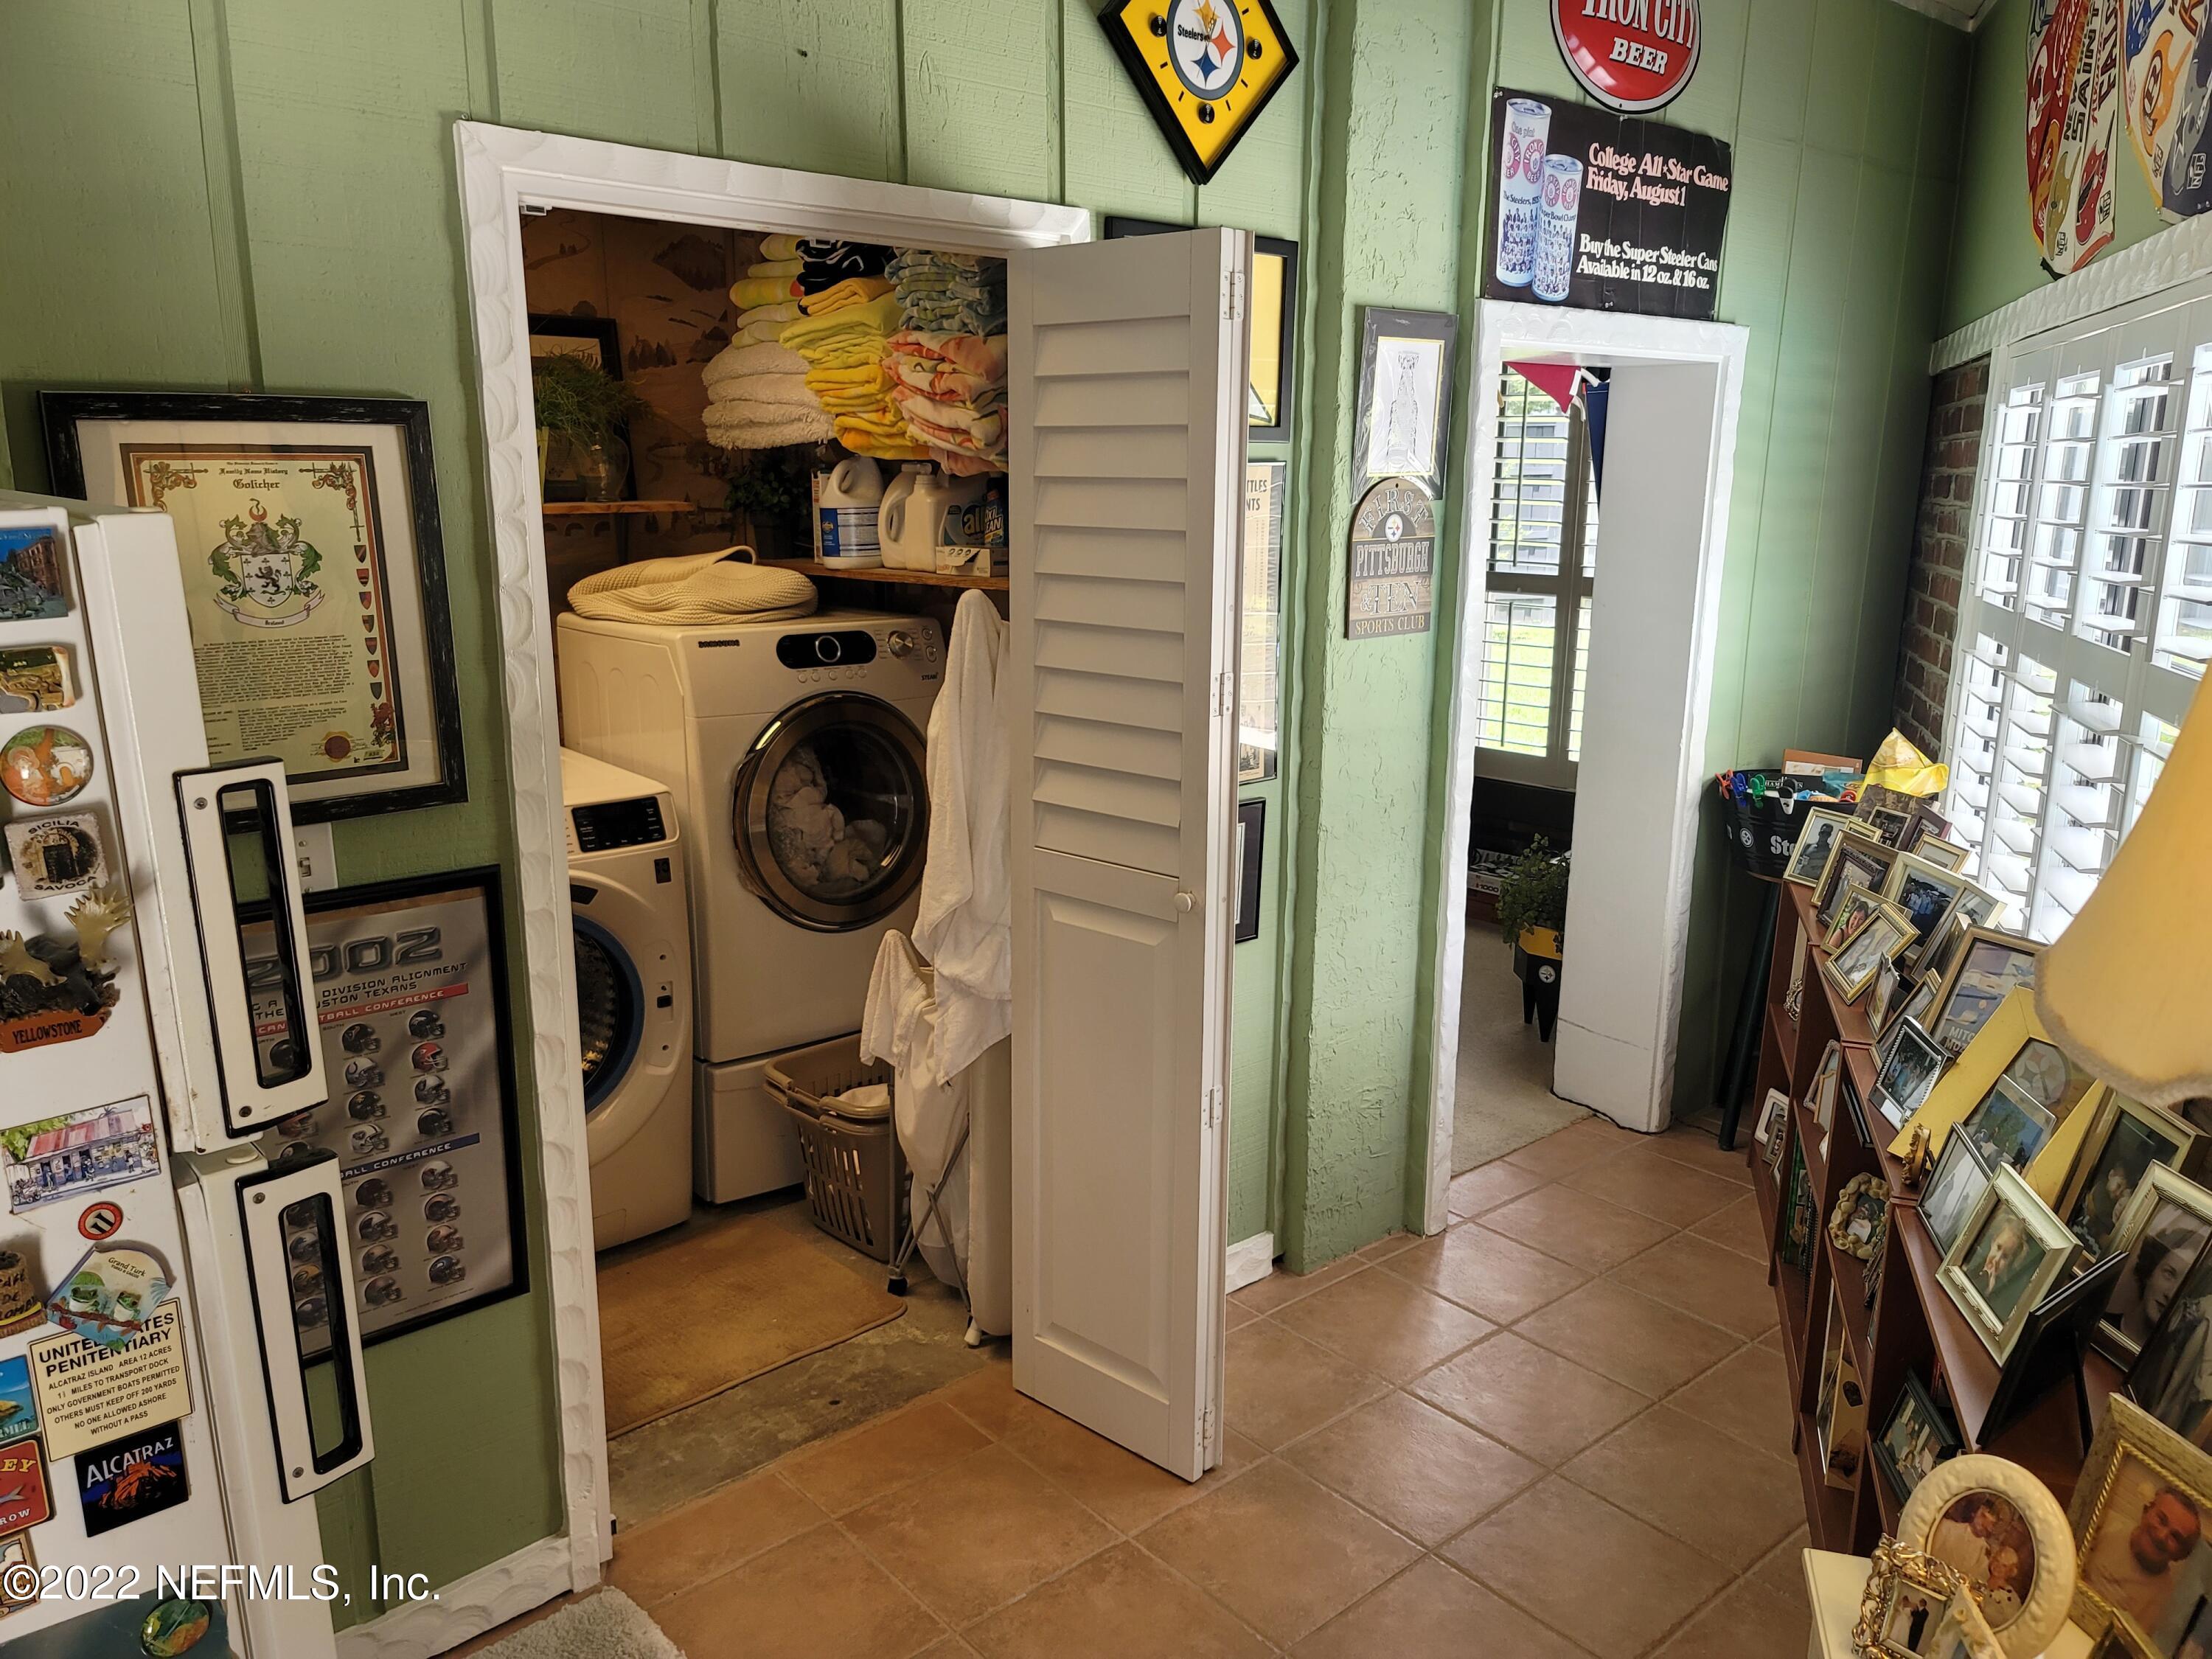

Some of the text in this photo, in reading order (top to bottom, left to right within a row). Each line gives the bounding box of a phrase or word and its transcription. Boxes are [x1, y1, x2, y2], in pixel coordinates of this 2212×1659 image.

[1178, 24, 1203, 42] Steelers
[1609, 37, 1668, 74] BEER
[1589, 142, 1636, 176] College
[1694, 165, 1729, 192] Game
[1510, 194, 1531, 206] Steelers,
[1586, 167, 1687, 206] Friday, August 1
[1551, 211, 1563, 221] Bowl
[1579, 233, 1718, 272] Buy the Super Steeler Cans
[1576, 254, 1710, 290] Available in 12 oz. & 16 oz.
[219, 467, 243, 476] Family
[263, 467, 288, 476] History
[233, 479, 280, 491] Golicher
[1359, 488, 1428, 538] FIRST
[1355, 541, 1429, 577] PITTSBURGH
[1368, 580, 1423, 614] TEN
[1355, 614, 1425, 635] SPORTS CLUB
[28, 820, 80, 835] SICILIA
[34, 876, 97, 891] SAVOCA
[322, 978, 386, 998] DIVISION
[392, 962, 468, 983] ALIGNMENT
[255, 1008, 285, 1020] THE
[364, 981, 417, 999] TEXANS
[365, 990, 444, 1012] CONFERENCE
[13, 1019, 83, 1044] YELLOWSTONE
[374, 1143, 452, 1169] CONFERENCE
[108, 1257, 146, 1276] Grand Turk
[49, 1345, 172, 1390] ALCATRAZ ISLAND AREA 12 ACRES
[72, 1383, 93, 1395] MILES
[105, 1365, 147, 1384] TRANSPORT
[149, 1357, 169, 1369] DOCK
[46, 1366, 180, 1414] ONLY GOVERNMENT BOATS PERMITTED
[54, 1378, 177, 1424] OTHERS MUST KEEP OFF 200 YARDS
[74, 1393, 167, 1429] NO ONE ALLOWED ASHORE
[91, 1419, 122, 1435] WITHOUT
[131, 1411, 148, 1422] PASS
[87, 1437, 174, 1488] ALCATRAZ
